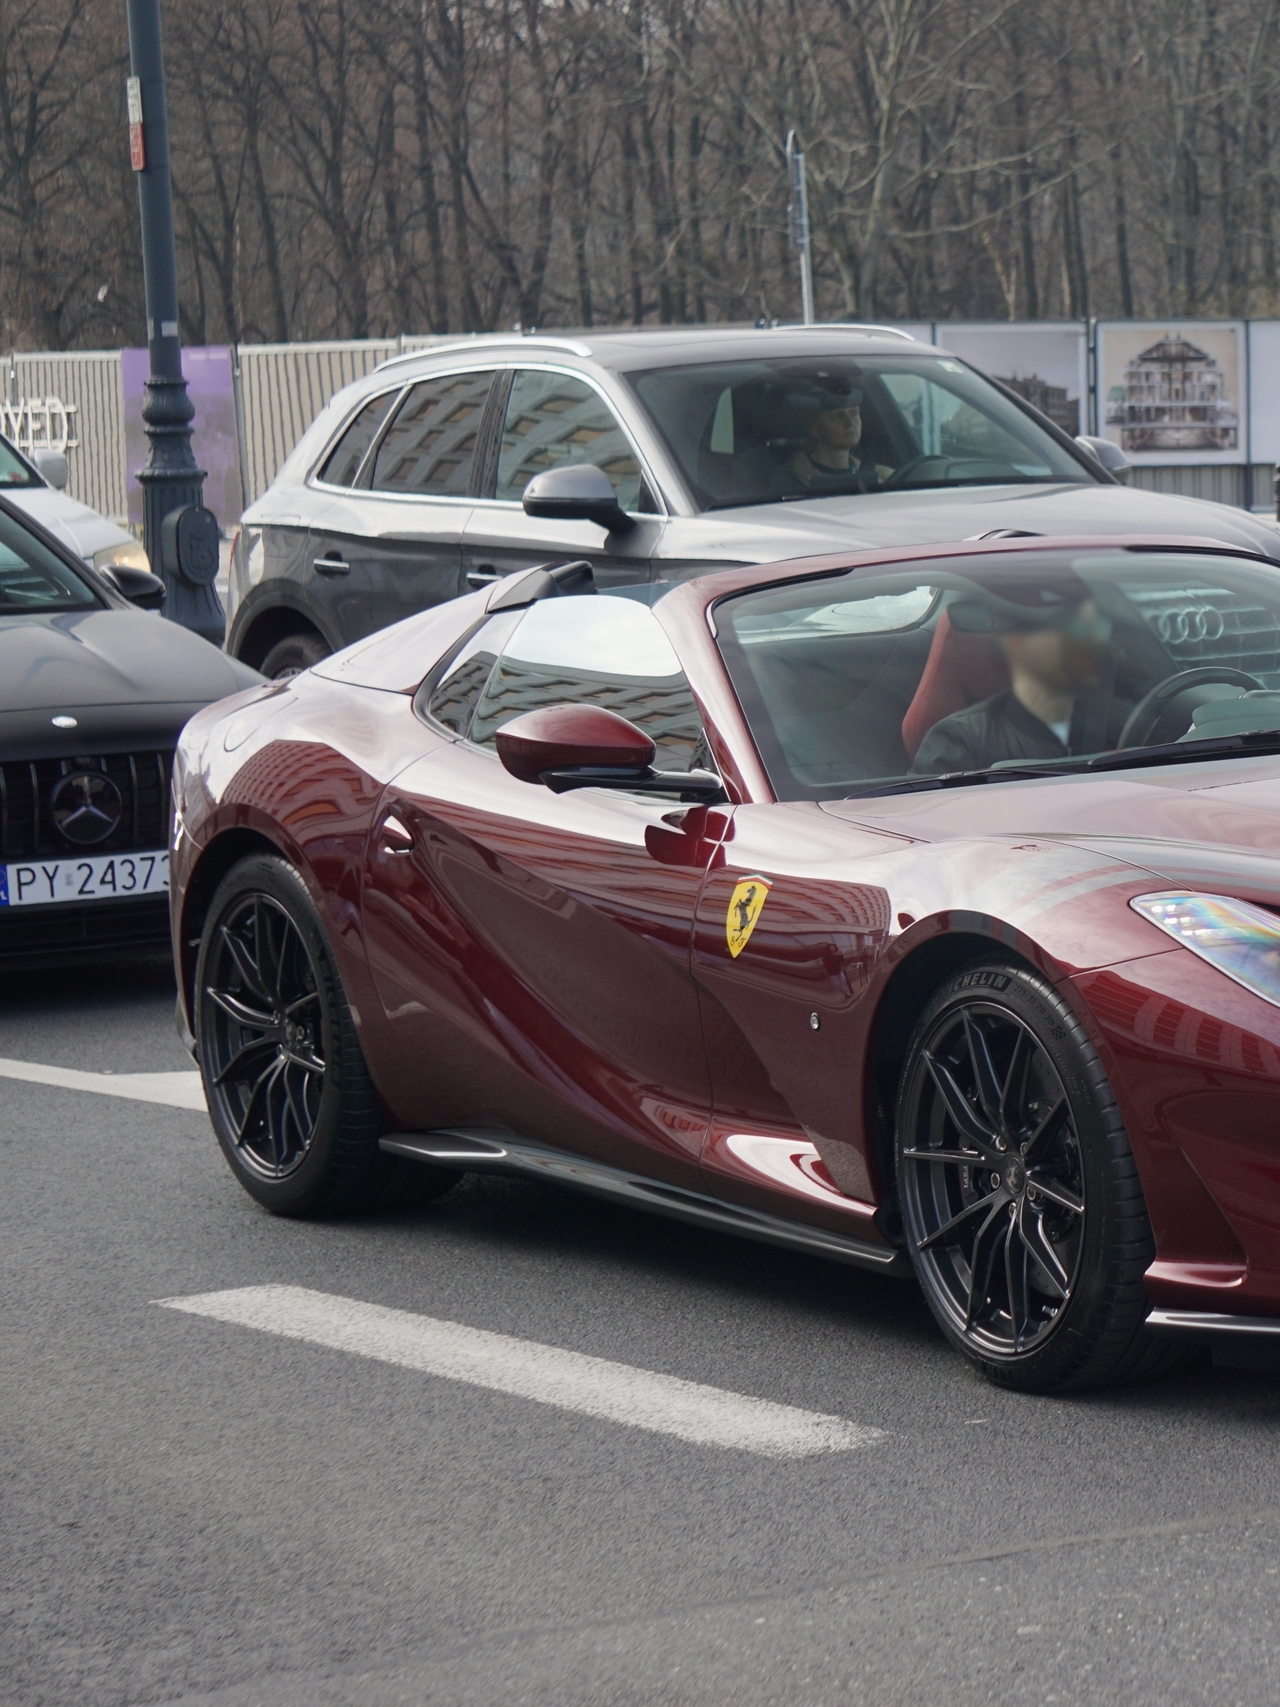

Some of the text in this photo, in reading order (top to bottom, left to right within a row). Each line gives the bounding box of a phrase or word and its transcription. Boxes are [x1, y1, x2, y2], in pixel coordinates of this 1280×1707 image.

[16, 864, 59, 901] PY
[1013, 985, 1036, 1005] 275/35
[1035, 1002, 1046, 1015] ZR
[1044, 1014, 1055, 1026] 20
